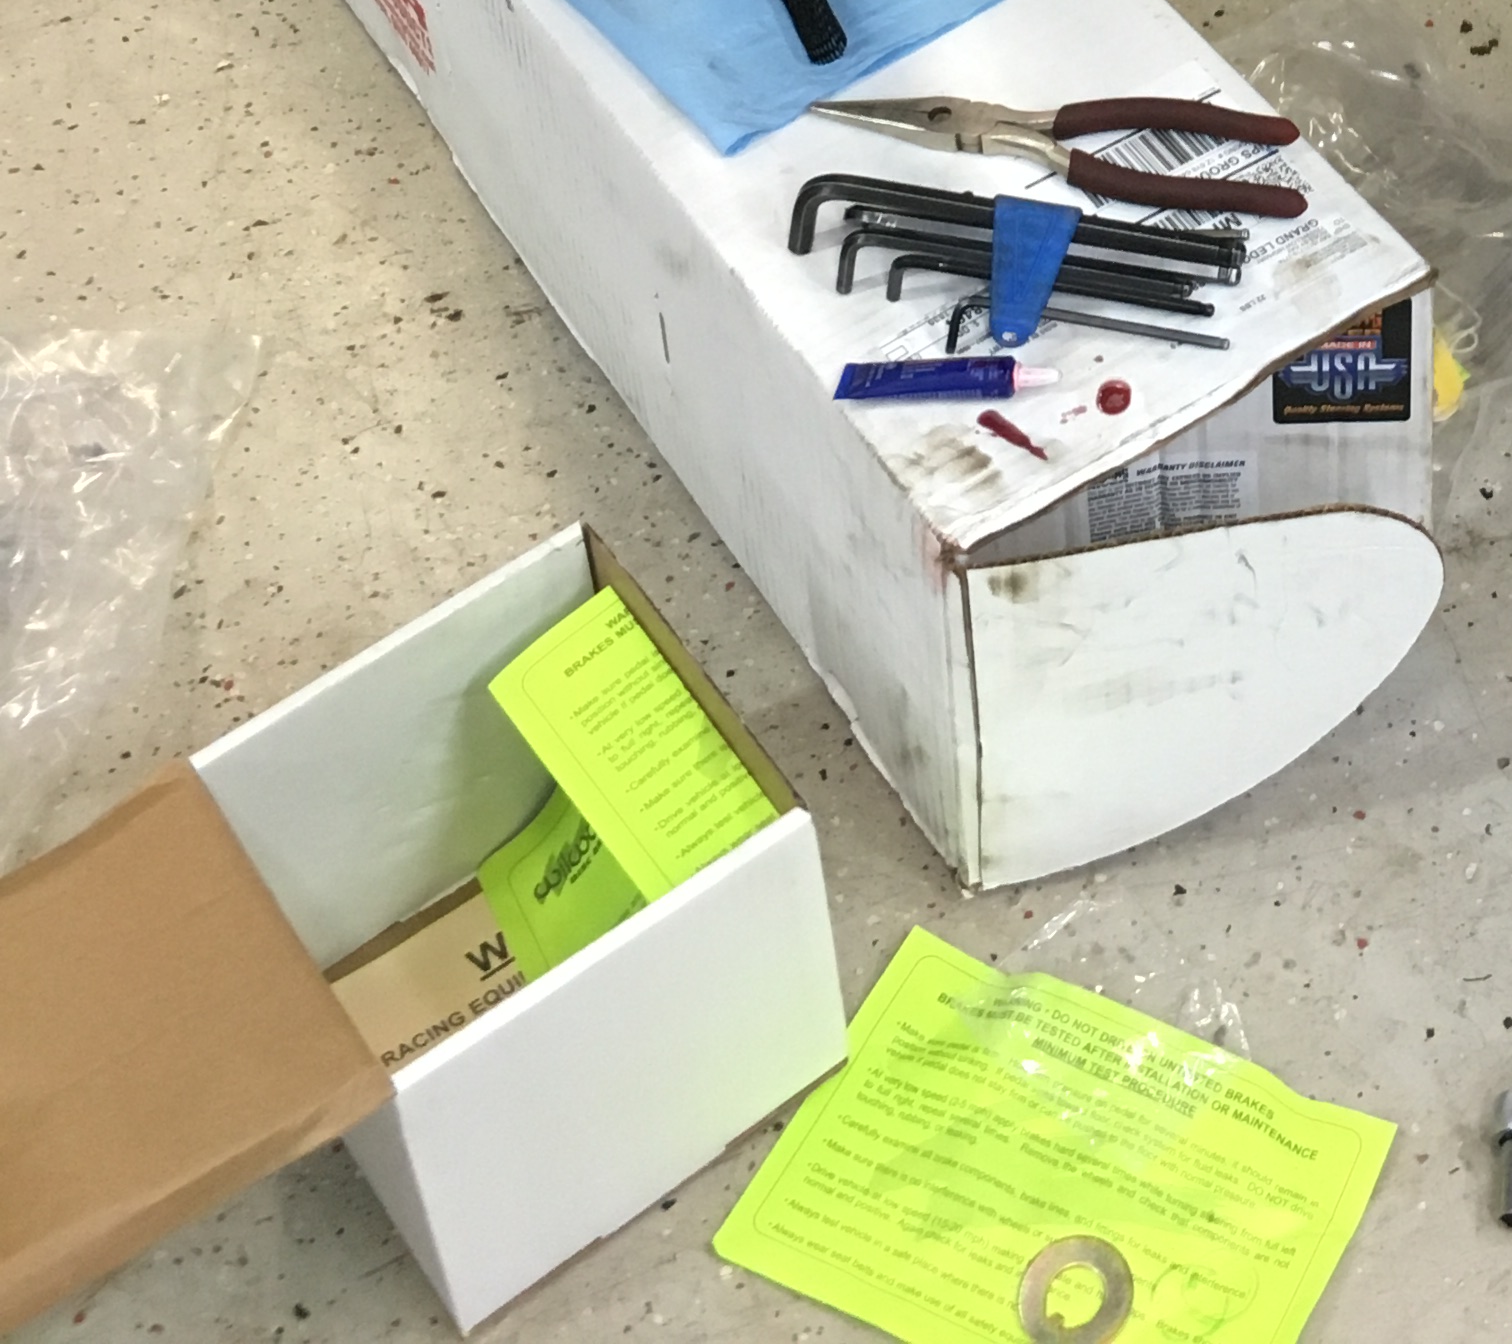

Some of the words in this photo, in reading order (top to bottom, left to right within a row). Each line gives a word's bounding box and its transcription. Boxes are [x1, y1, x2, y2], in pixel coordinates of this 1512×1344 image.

[1273, 216, 1319, 246] GRAND
[1309, 350, 1376, 400] USA
[1136, 461, 1187, 478] WARRANTY
[564, 637, 614, 676] BRAKES
[463, 930, 515, 976] W
[379, 1007, 467, 1068] RACING
[1030, 1036, 1087, 1071] MINIMUM
[1085, 1060, 1120, 1084] TEST
[1013, 1011, 1033, 1026] BE
[1035, 1018, 1081, 1047] TESTED
[1081, 1041, 1123, 1066] AFTER
[1210, 1099, 1230, 1116] OR
[1231, 1108, 1318, 1160] MAINTENANCE
[1050, 1008, 1070, 1024] DO
[1070, 1018, 1099, 1037] NOT
[1223, 1087, 1274, 1120] BRAKES
[1246, 1180, 1264, 1196] DO
[1264, 1191, 1289, 1207] NOT
